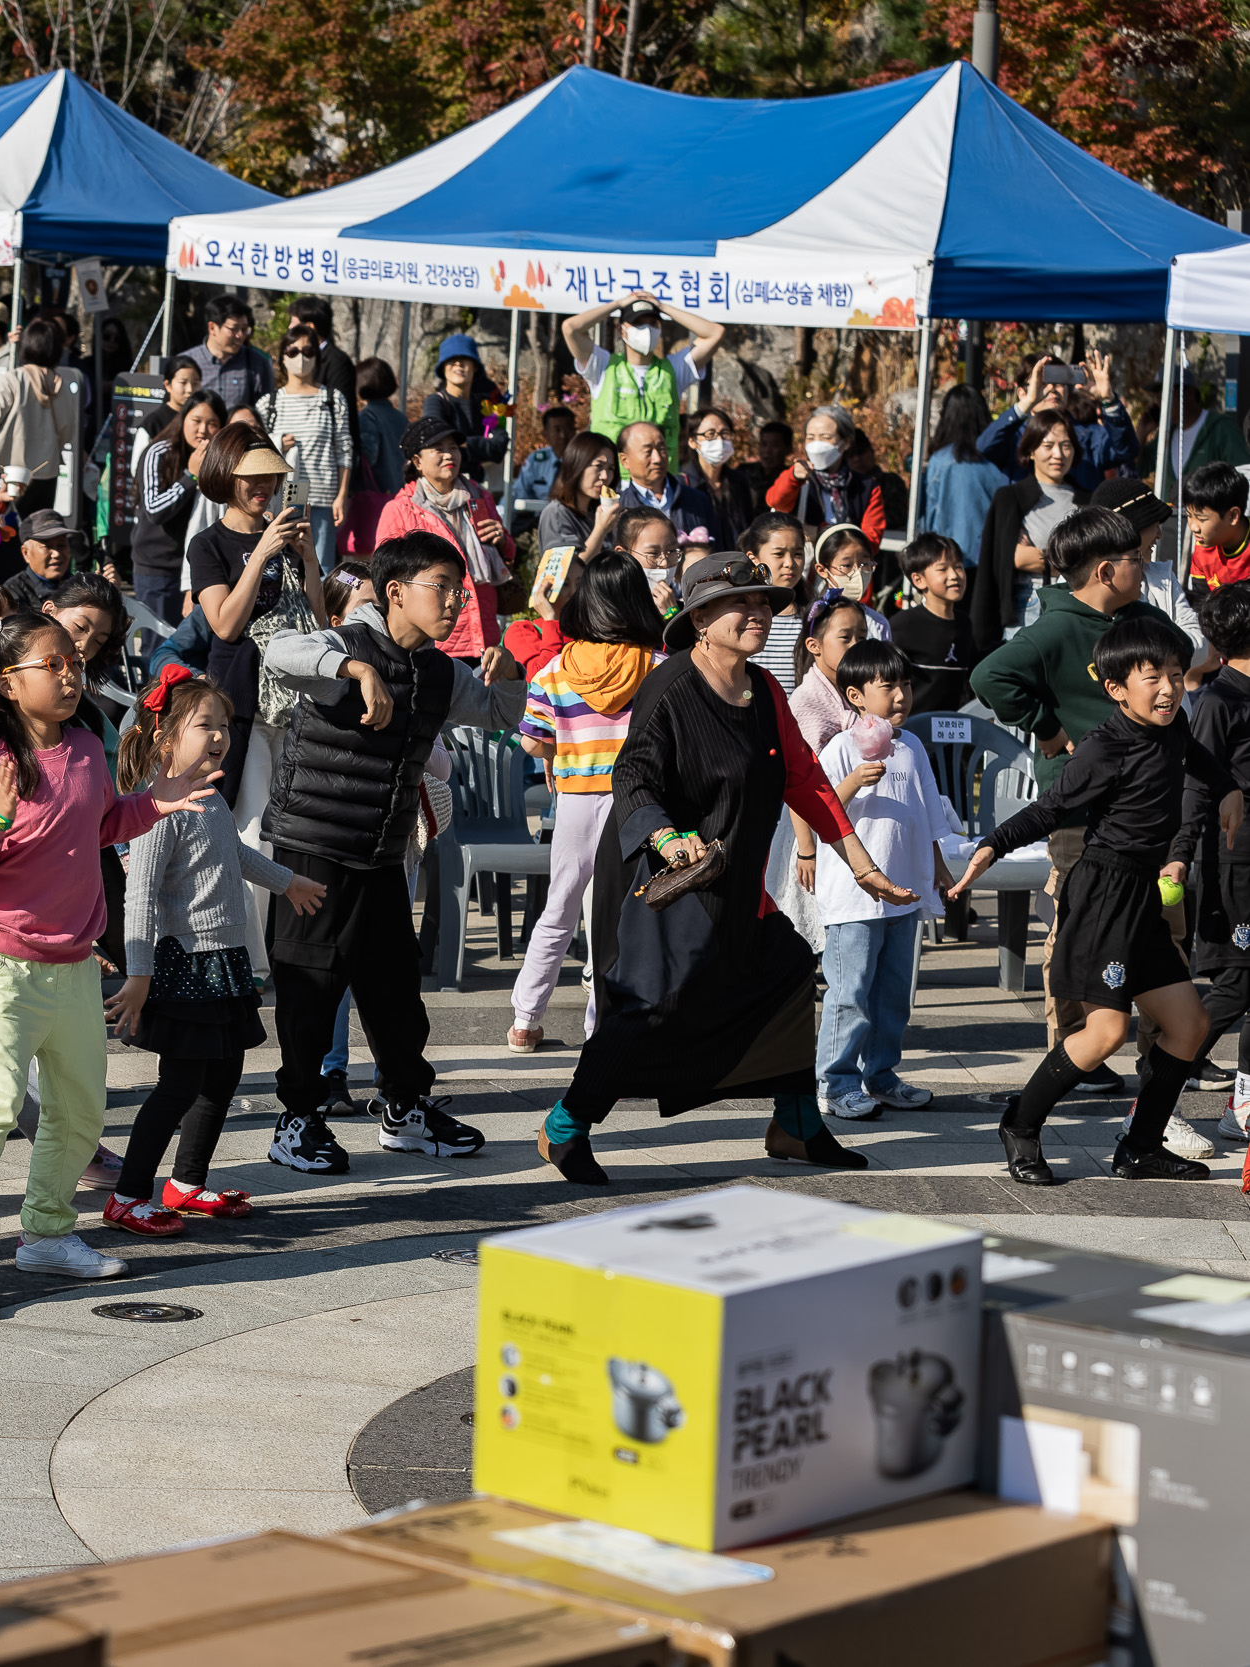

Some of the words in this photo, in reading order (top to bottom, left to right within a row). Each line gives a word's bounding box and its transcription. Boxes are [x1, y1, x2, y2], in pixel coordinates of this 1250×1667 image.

[204, 240, 339, 284] 오석한방병원
[565, 265, 730, 310] 재난구조협회
[735, 279, 814, 307] (심폐소생술
[817, 281, 854, 309] 체험)
[891, 772, 907, 781] TOM
[734, 1367, 834, 1425] BLACK
[732, 1405, 830, 1464] PEARL
[731, 1455, 804, 1493] TRENDY
